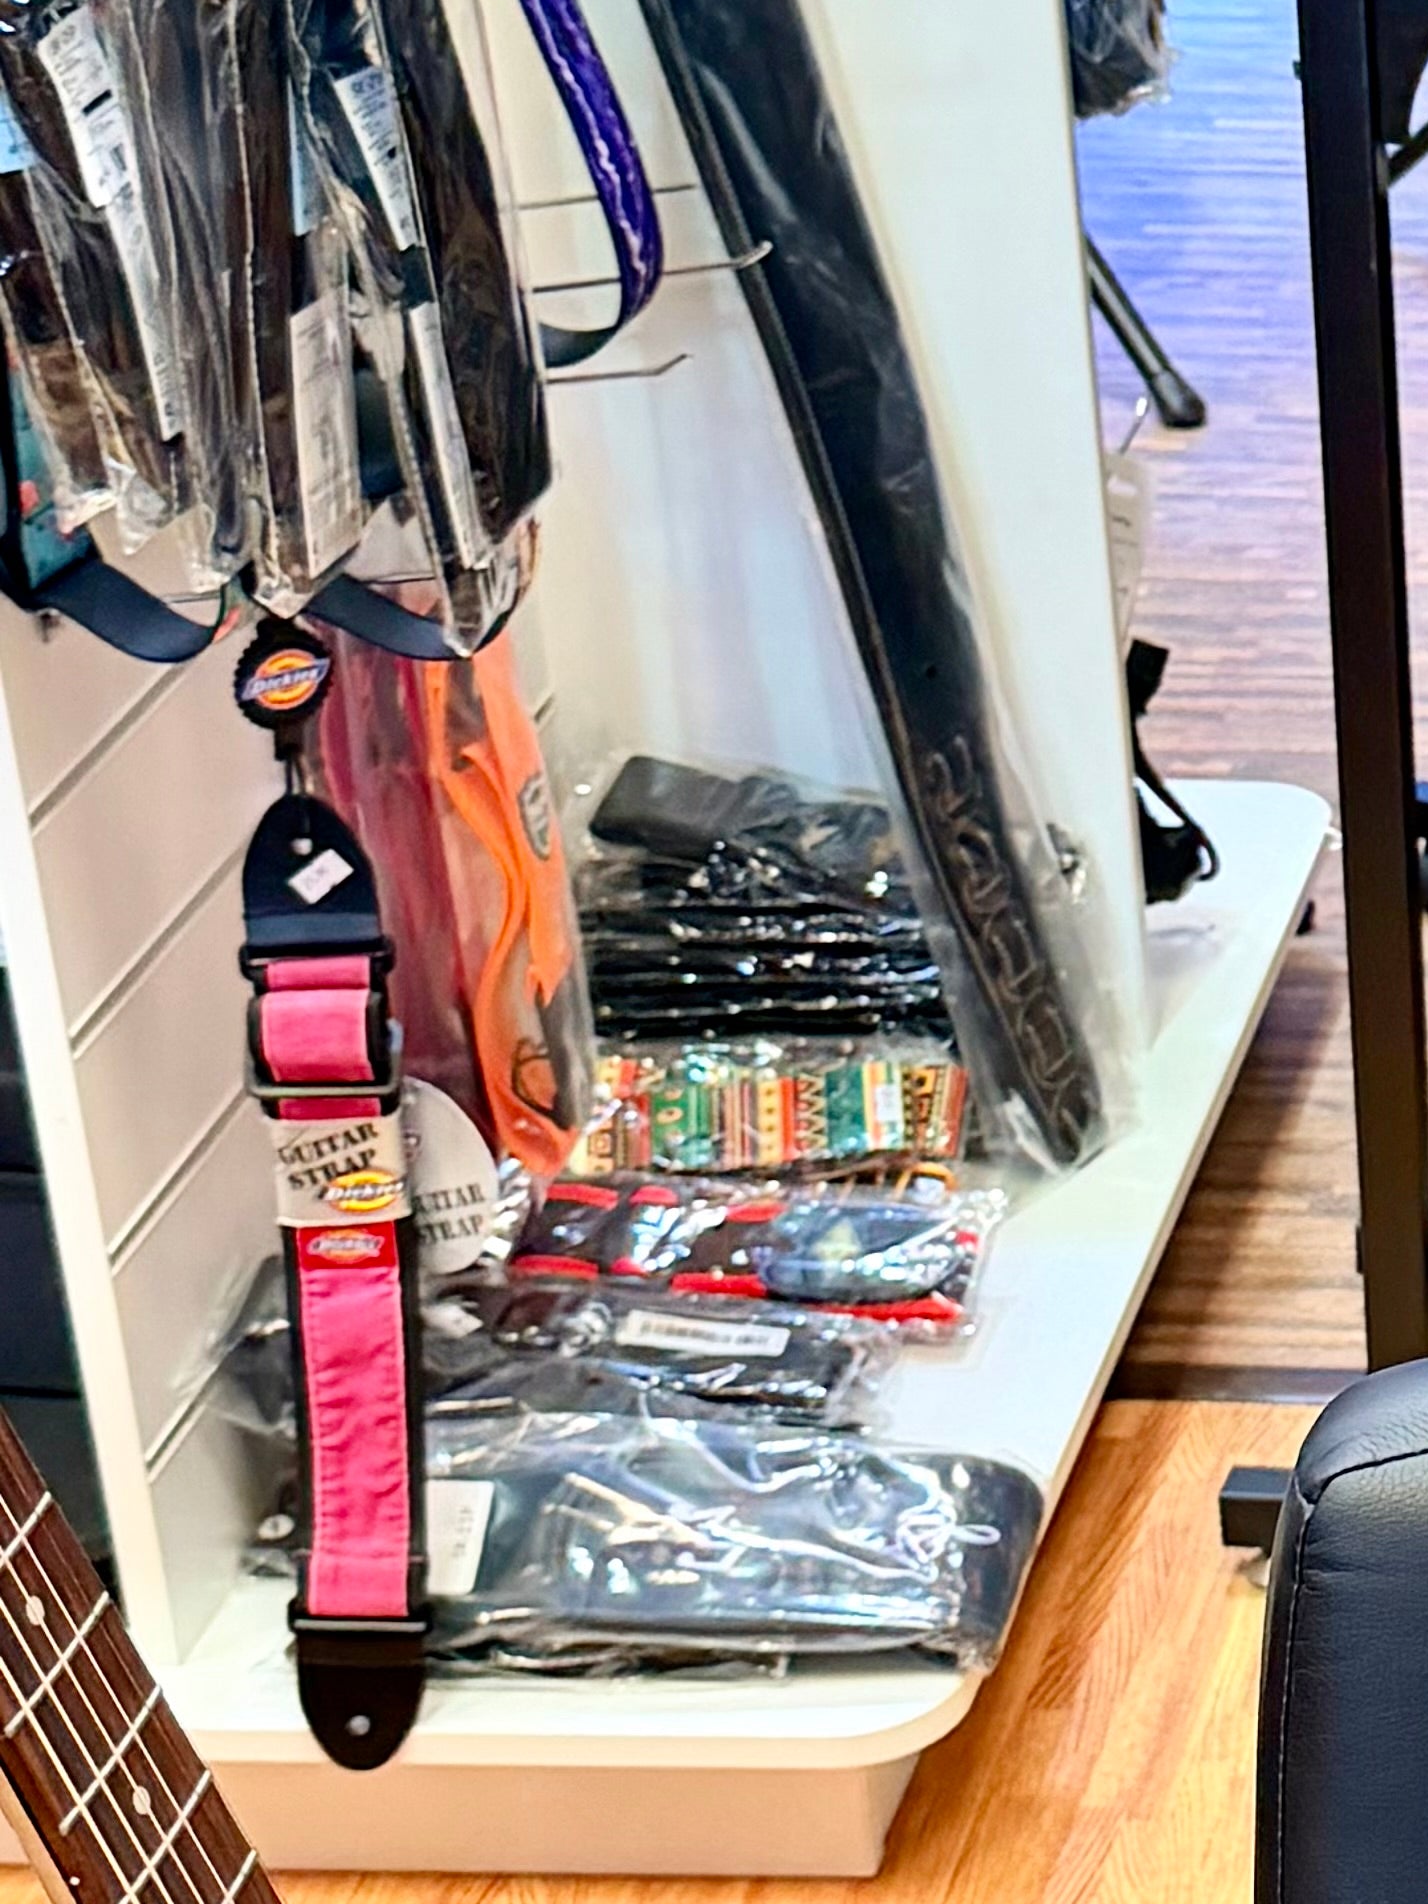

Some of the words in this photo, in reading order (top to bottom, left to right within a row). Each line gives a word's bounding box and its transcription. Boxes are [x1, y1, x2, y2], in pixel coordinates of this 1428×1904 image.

[252, 665, 320, 695] Dickies
[278, 1122, 379, 1165] GUITAR
[287, 1148, 377, 1190] STRAP
[324, 1180, 404, 1202] Dickies
[411, 1182, 487, 1213] UITAR
